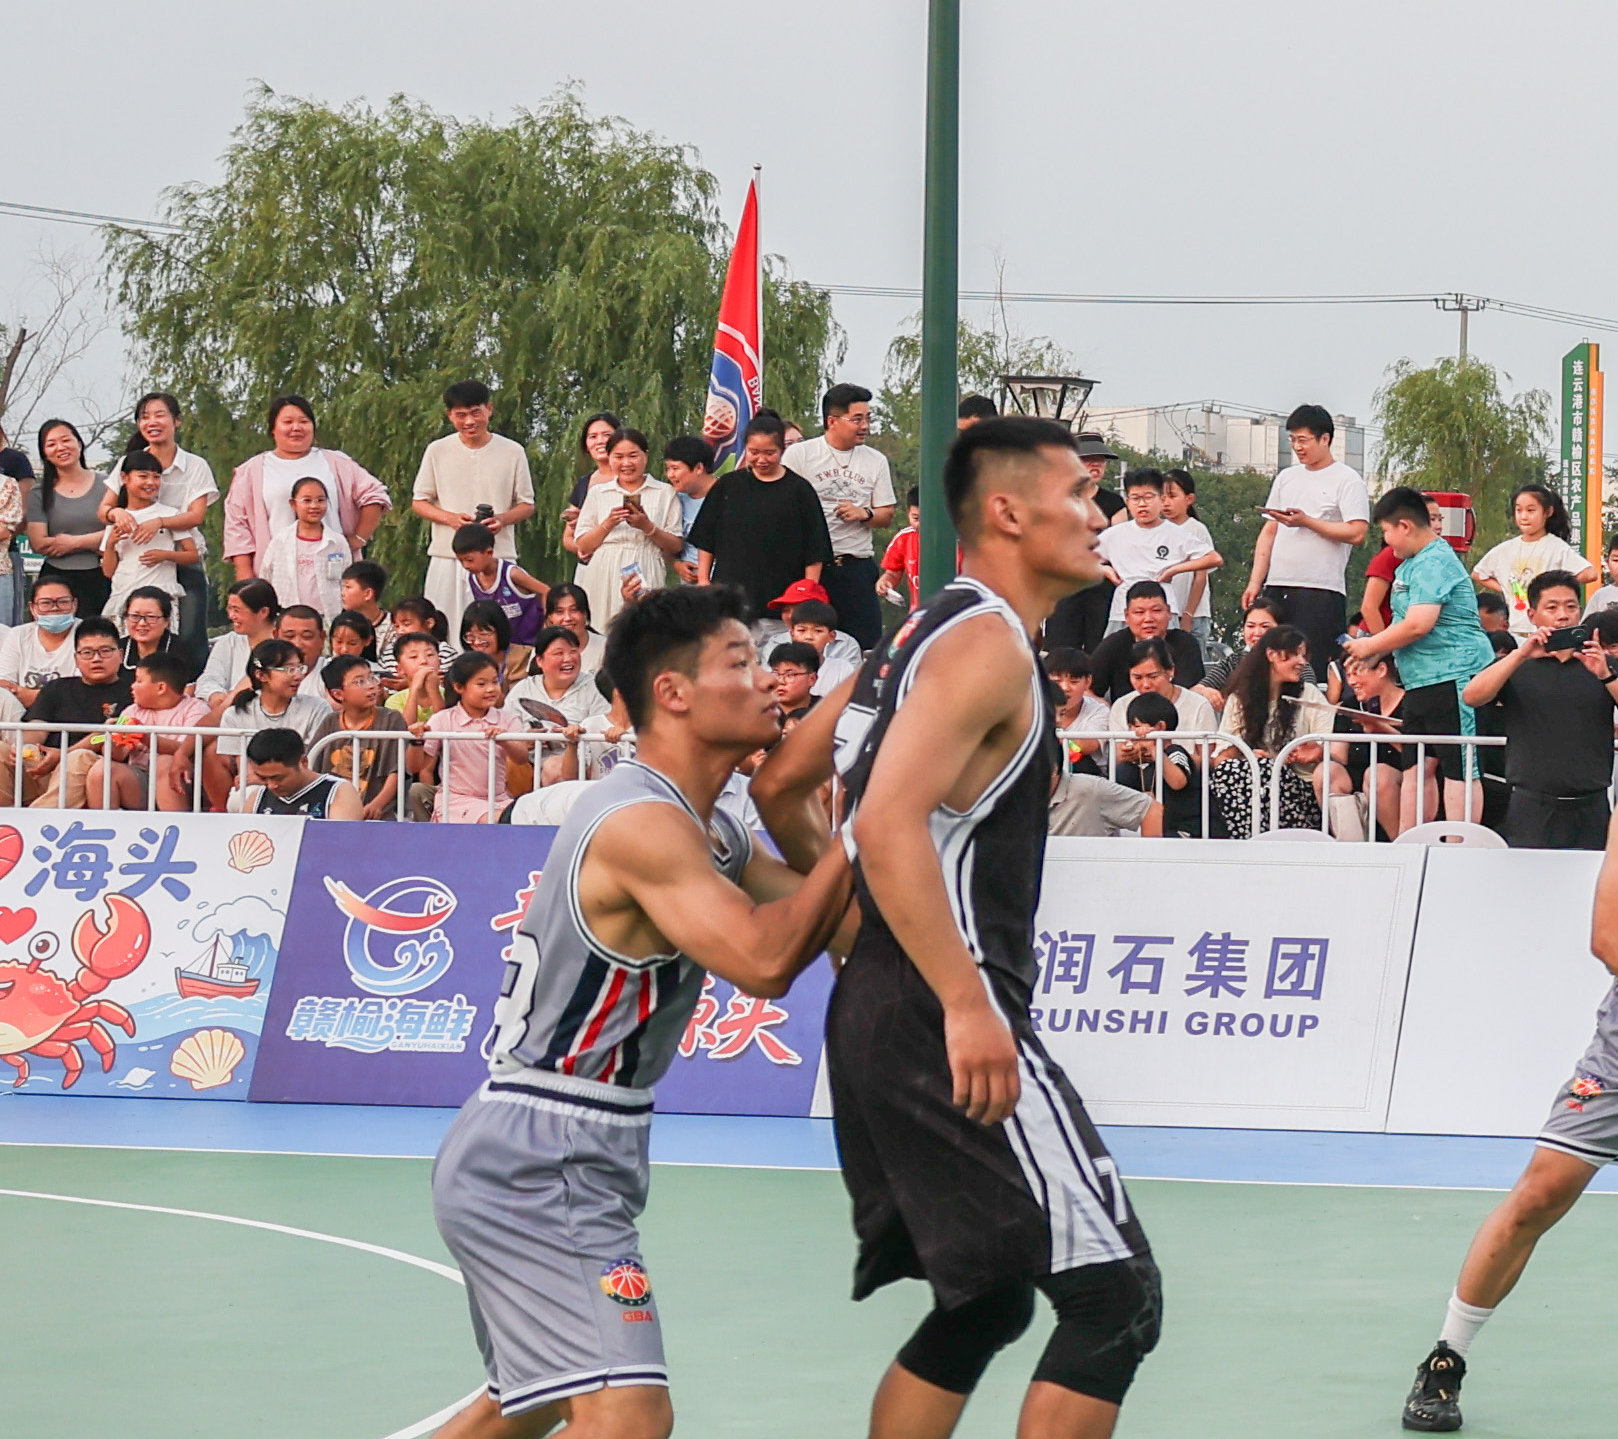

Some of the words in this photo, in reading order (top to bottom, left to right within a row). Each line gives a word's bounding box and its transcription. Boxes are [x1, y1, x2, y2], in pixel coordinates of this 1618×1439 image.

[843, 470, 866, 485] CLUB
[24, 820, 198, 903] 海头
[1031, 930, 1331, 1001] 润石集团
[288, 995, 478, 1041] 赣榆海鲜
[1028, 1008, 1169, 1034] RUNSHI
[1185, 1011, 1319, 1038] GROUP
